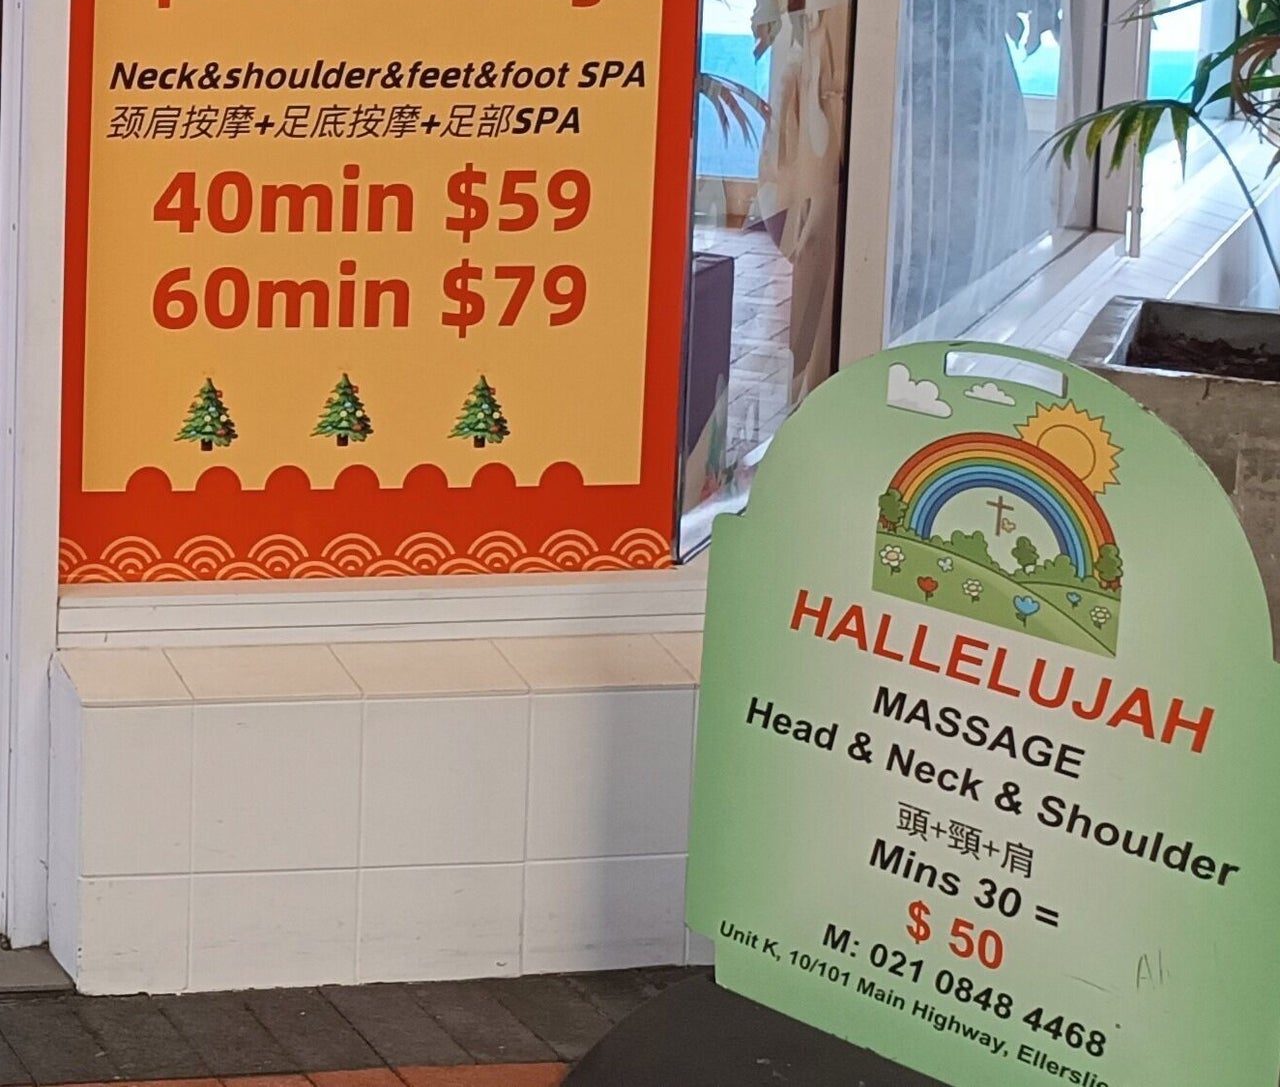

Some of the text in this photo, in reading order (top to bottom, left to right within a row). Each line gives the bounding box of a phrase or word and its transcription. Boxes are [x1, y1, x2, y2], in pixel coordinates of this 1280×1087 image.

[109, 60, 647, 90] Neck&shoulder&feet&foot SPA
[106, 104, 580, 141] 颈肩按摩+足底按摩+足部SPA
[152, 162, 592, 243] 40min $59
[151, 258, 587, 339] 60min $79
[789, 589, 1216, 753] HALLELUJAH
[872, 686, 1085, 778] MASSAGE
[745, 697, 1240, 887] Head & Neck & Shoulder
[869, 838, 962, 897] Mins
[974, 877, 1023, 917] 30
[906, 900, 1005, 970] $ 50
[719, 920, 759, 950] Unit
[762, 937, 781, 962] K,
[789, 950, 851, 987] 10/101
[856, 977, 905, 1011] Main
[911, 1000, 1009, 1058] Highway,
[822, 923, 1106, 1057] M: 021 0848 4468
